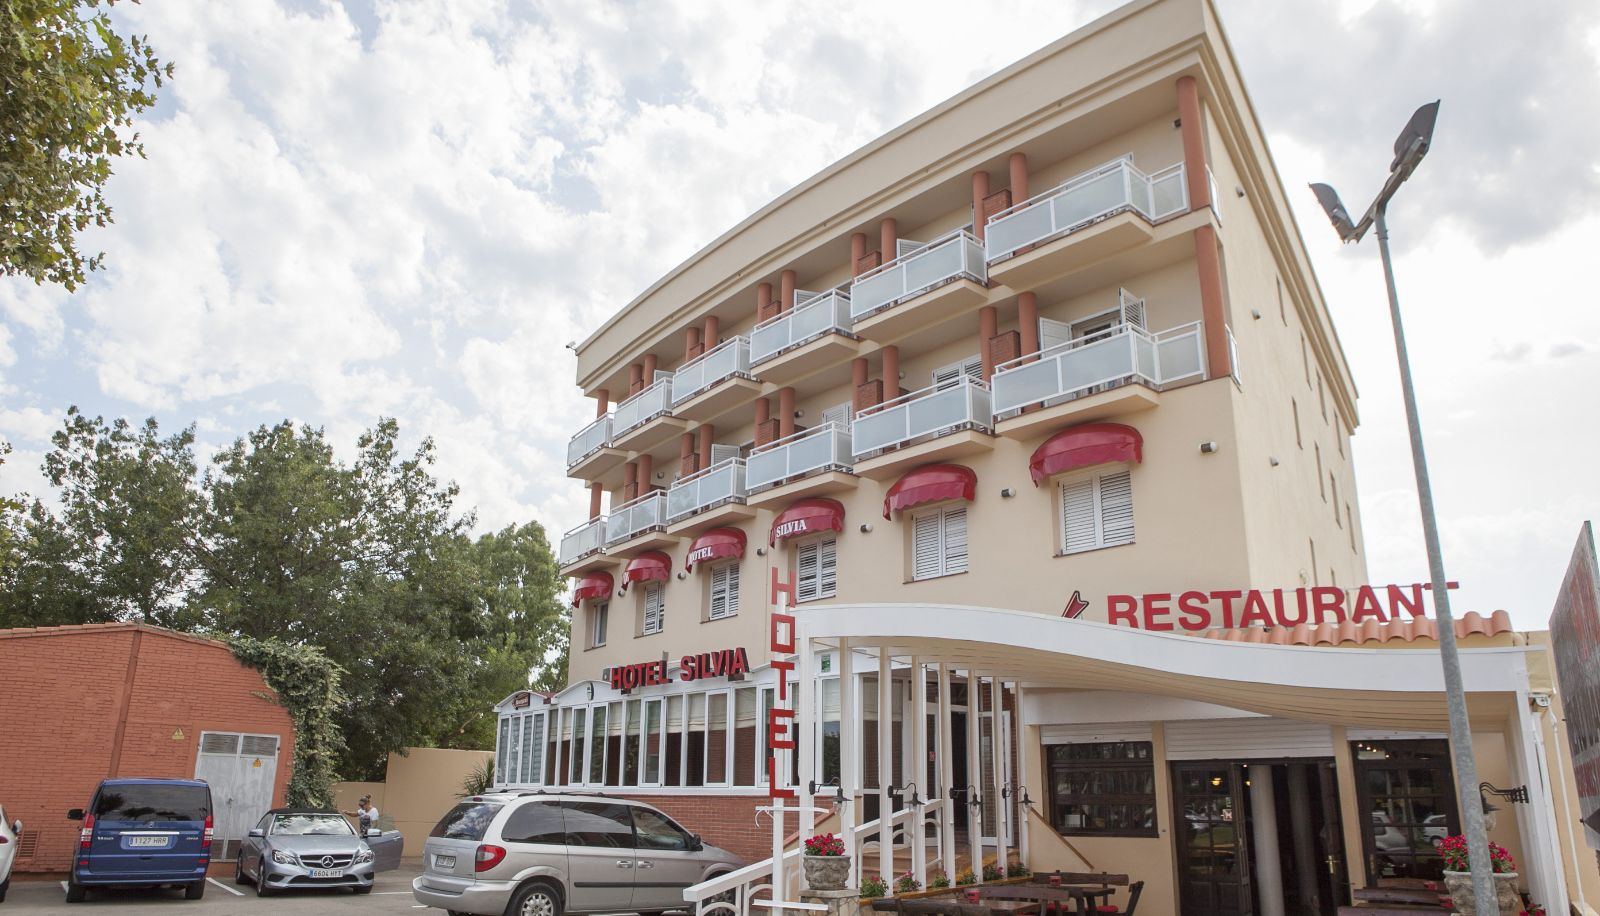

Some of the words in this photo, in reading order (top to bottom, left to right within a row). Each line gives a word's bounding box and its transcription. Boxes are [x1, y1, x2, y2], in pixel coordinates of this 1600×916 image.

[775, 519, 807, 538] SILVIA
[611, 660, 672, 690] HOTEL
[680, 647, 749, 681] SILVIA
[769, 566, 796, 798] HOTEL
